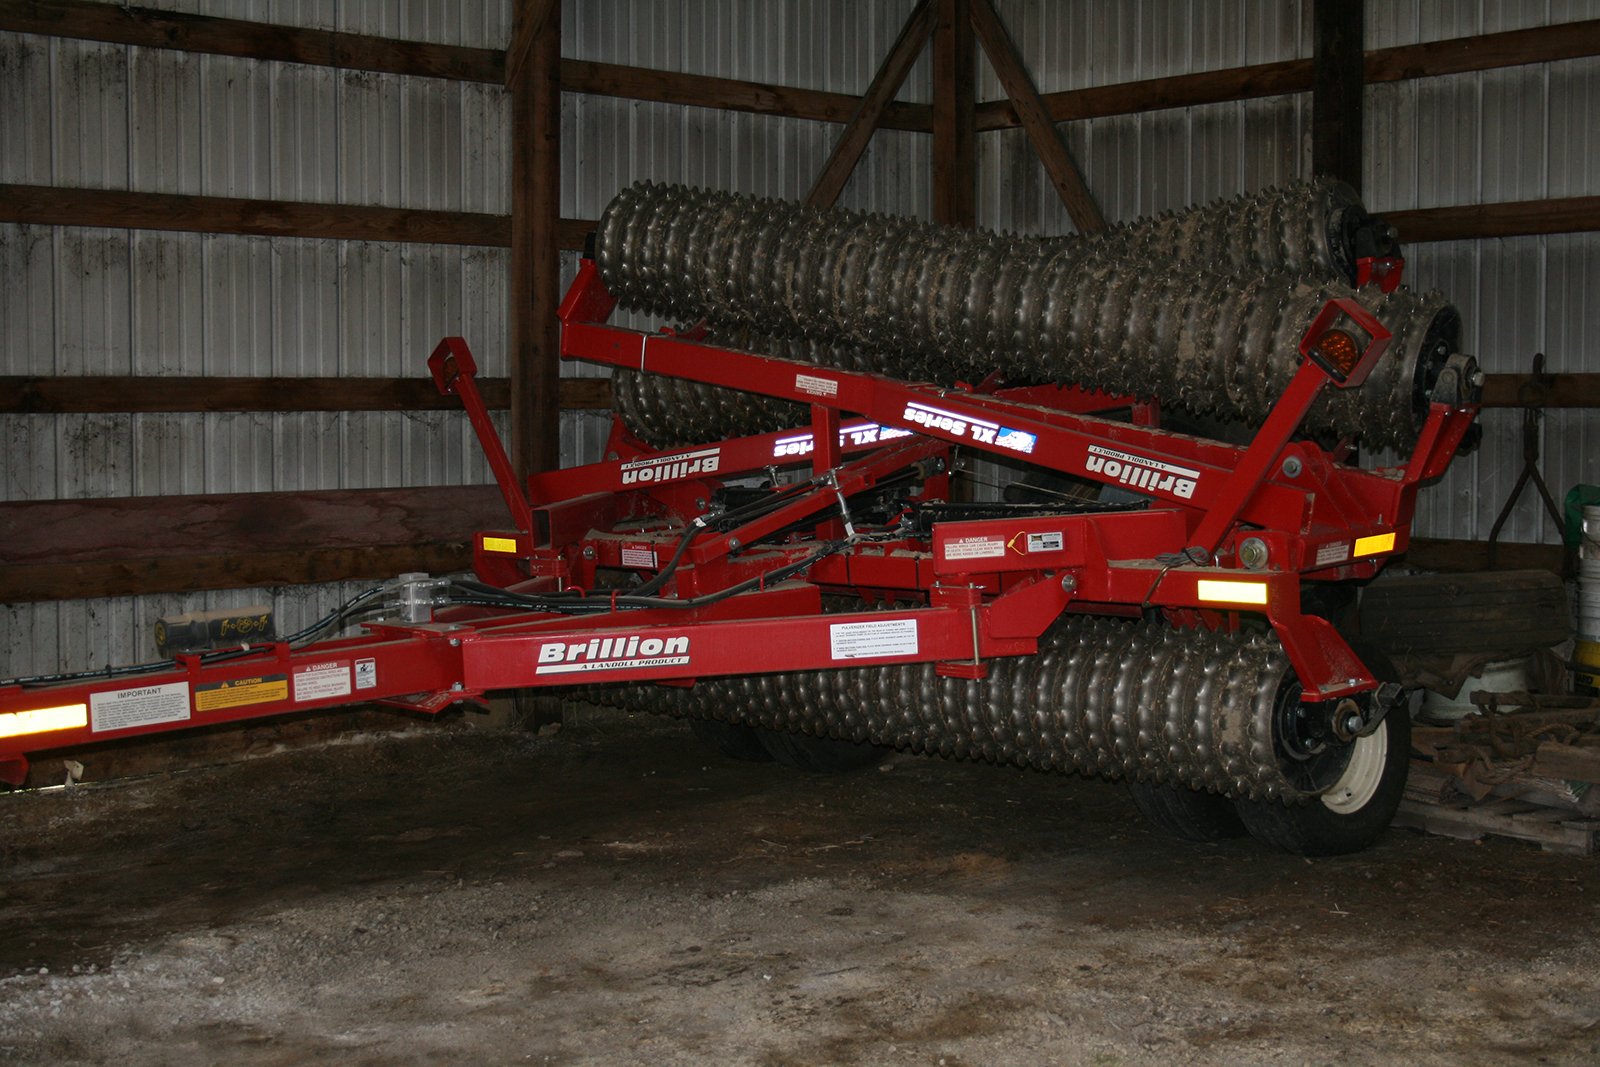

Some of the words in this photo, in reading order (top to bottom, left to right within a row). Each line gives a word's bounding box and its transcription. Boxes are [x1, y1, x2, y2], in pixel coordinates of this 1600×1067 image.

[903, 408, 967, 436] Series
[851, 429, 878, 445] XL
[971, 426, 996, 444] XL
[1093, 447, 1125, 459] PRODUCT
[1127, 457, 1159, 468] LANDOLL
[622, 456, 720, 484] Brillion
[1085, 455, 1197, 499] Brillion
[538, 636, 689, 663] Brillion
[312, 662, 338, 671] DANGER
[638, 657, 682, 665] PRODUCT
[234, 677, 262, 686] CAUTION
[117, 687, 162, 699] IMPORTANT
